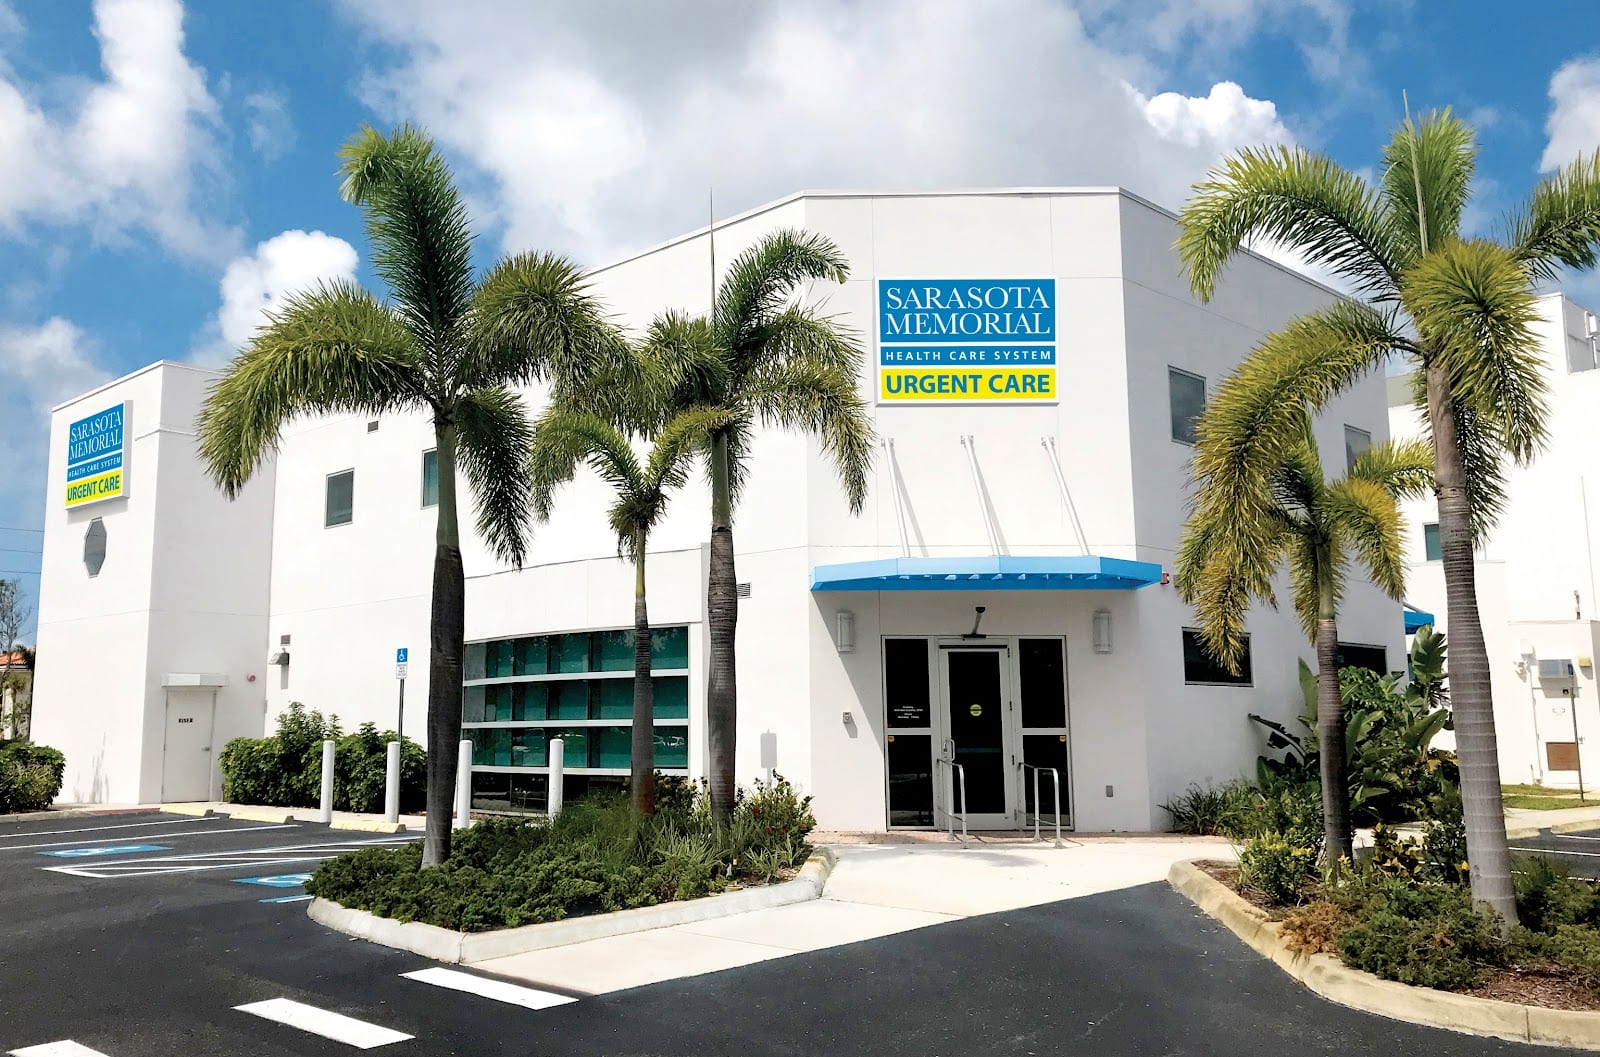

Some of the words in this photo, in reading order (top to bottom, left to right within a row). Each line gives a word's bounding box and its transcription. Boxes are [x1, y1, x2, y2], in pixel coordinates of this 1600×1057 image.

[886, 287, 1050, 309] SARASOTA
[885, 312, 1050, 335] MEMORIAL
[886, 351, 941, 361] HEALTH
[950, 351, 986, 360] CARE
[994, 350, 1051, 360] SYSTEM
[886, 375, 982, 393] URGENT
[988, 374, 1050, 393] CARE
[70, 411, 122, 443] SARASOTA
[69, 429, 122, 460] MEMORIAL
[69, 468, 86, 478] HEALTH
[86, 463, 99, 473] CARE
[101, 456, 120, 469] SYSTEM
[67, 481, 97, 501] URGENT
[98, 475, 120, 494] CARE
